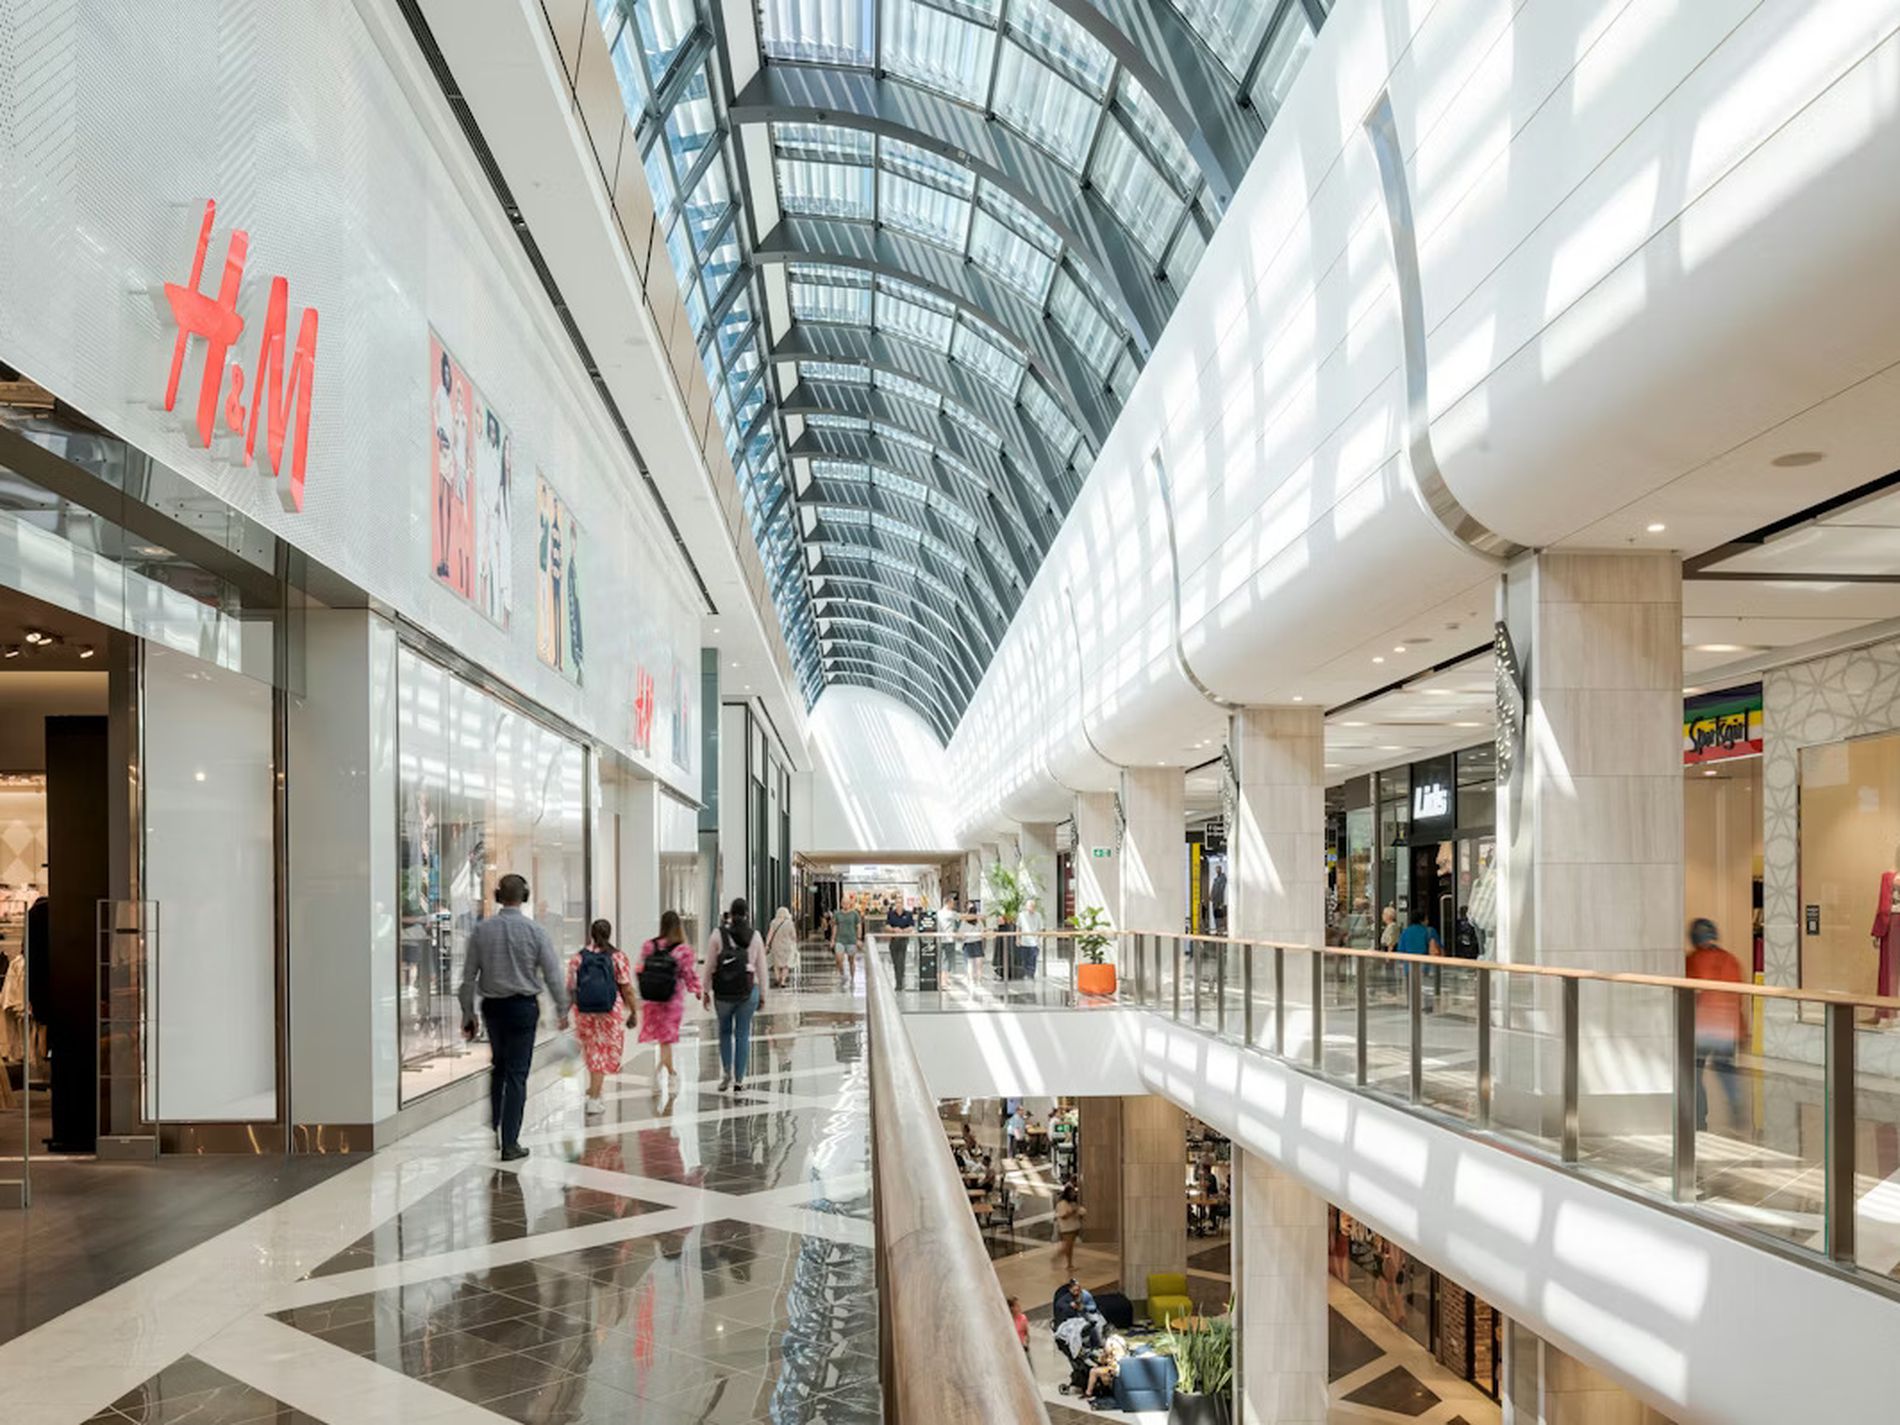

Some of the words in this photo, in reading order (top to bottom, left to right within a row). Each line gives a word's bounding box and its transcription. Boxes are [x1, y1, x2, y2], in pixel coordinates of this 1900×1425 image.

[163, 198, 319, 513] H&M
[633, 666, 655, 758] HM
[1688, 705, 1750, 755] Sportsgirl
[1413, 782, 1448, 820] Lids
